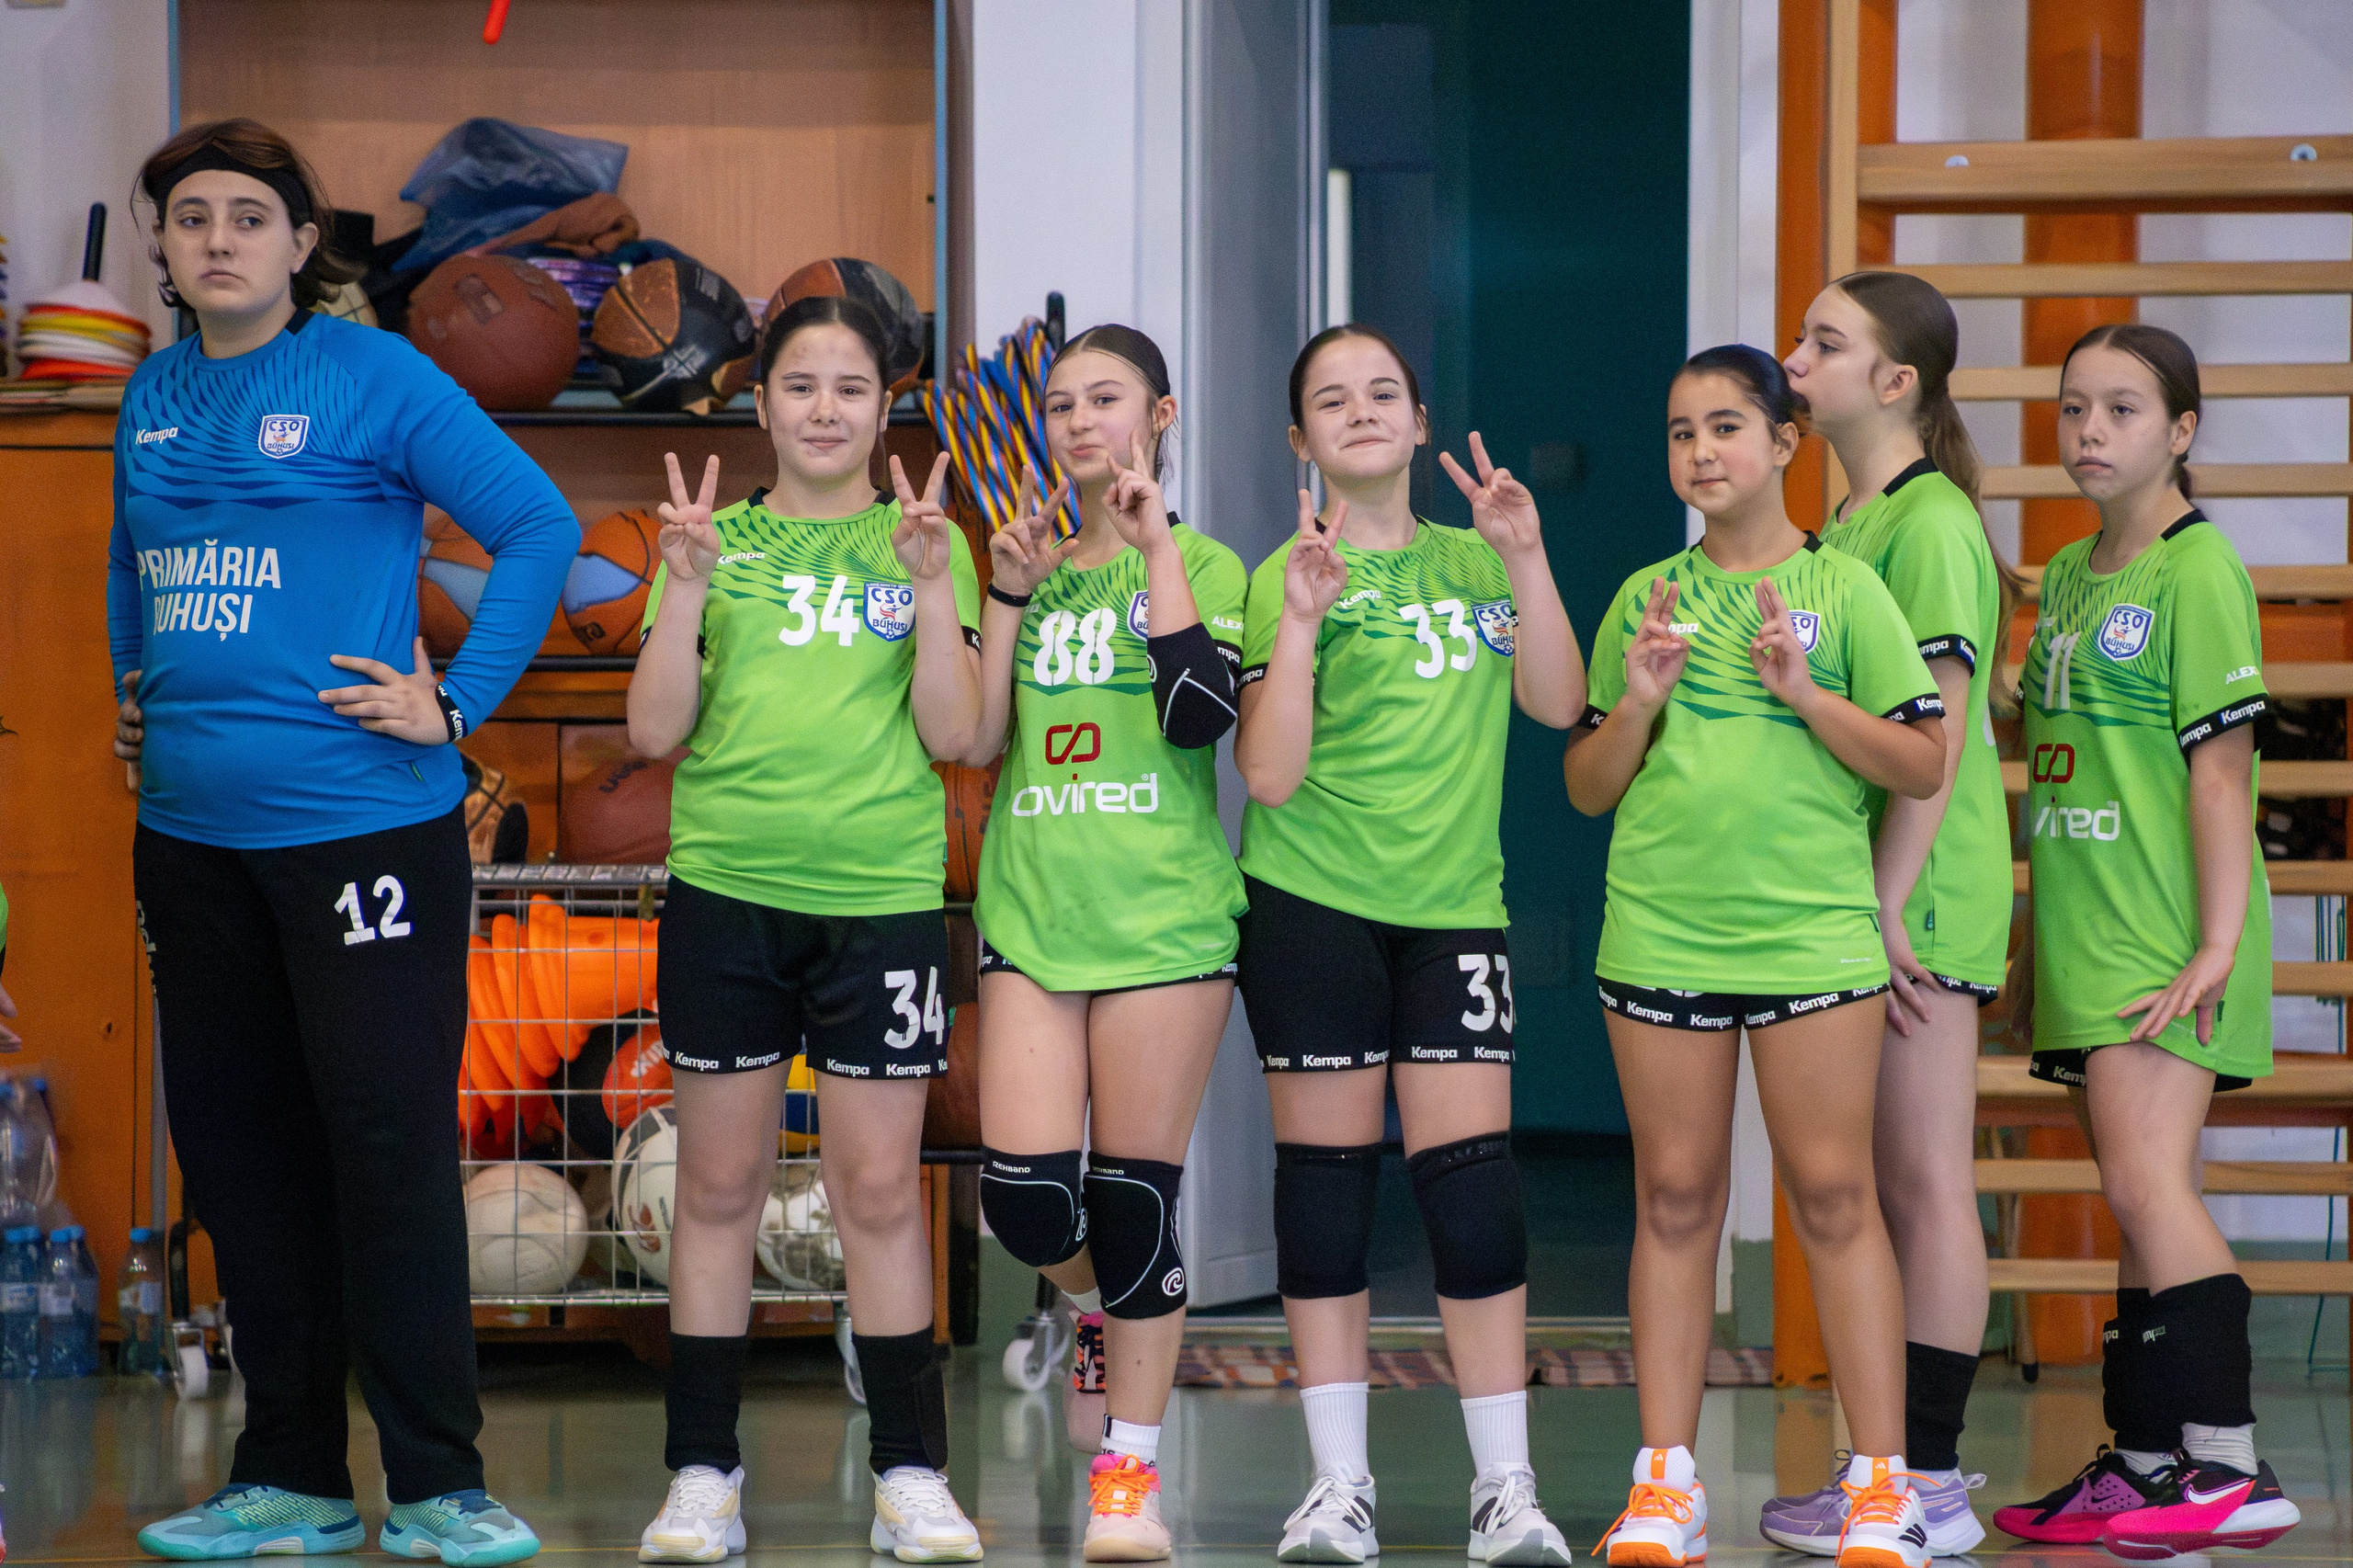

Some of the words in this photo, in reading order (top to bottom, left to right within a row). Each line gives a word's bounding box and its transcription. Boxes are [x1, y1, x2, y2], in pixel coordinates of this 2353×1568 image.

[135, 426, 178, 445] Kempa
[268, 421, 300, 432] CSO
[136, 539, 281, 592] PRIMĂRIA
[718, 551, 765, 564] Kempa
[870, 587, 914, 606] CSO
[1338, 589, 1381, 609] Kempa
[779, 574, 860, 646] 34
[2113, 610, 2144, 629] CSO
[1398, 598, 1477, 678] 33
[1668, 622, 1699, 635] mpa
[1033, 608, 1118, 686] 88
[1217, 646, 1241, 664] mpa
[1242, 668, 1264, 683] mpa
[2043, 631, 2082, 710] 11
[1916, 698, 1943, 711] Kemp
[2221, 700, 2266, 724] Kempa
[449, 709, 464, 742] Kem
[334, 874, 410, 946] 12
[1458, 954, 1513, 1034] 33
[883, 966, 945, 1050] 34
[1598, 985, 1618, 1008] Kempa
[1627, 1001, 1673, 1023] Kempa
[1690, 1014, 1733, 1029] Kempa
[1745, 1010, 1777, 1026] Kempa
[1788, 992, 1839, 1015] Kempa
[675, 1051, 719, 1072] Kempa
[735, 1051, 779, 1068] Kempa
[1267, 1055, 1290, 1070] Kempa
[1302, 1054, 1352, 1069] Kempa
[1411, 1046, 1458, 1062] Kempa
[827, 1058, 870, 1077] Kempa
[886, 1062, 931, 1077] Kempa
[2052, 1065, 2086, 1086] Kemp
